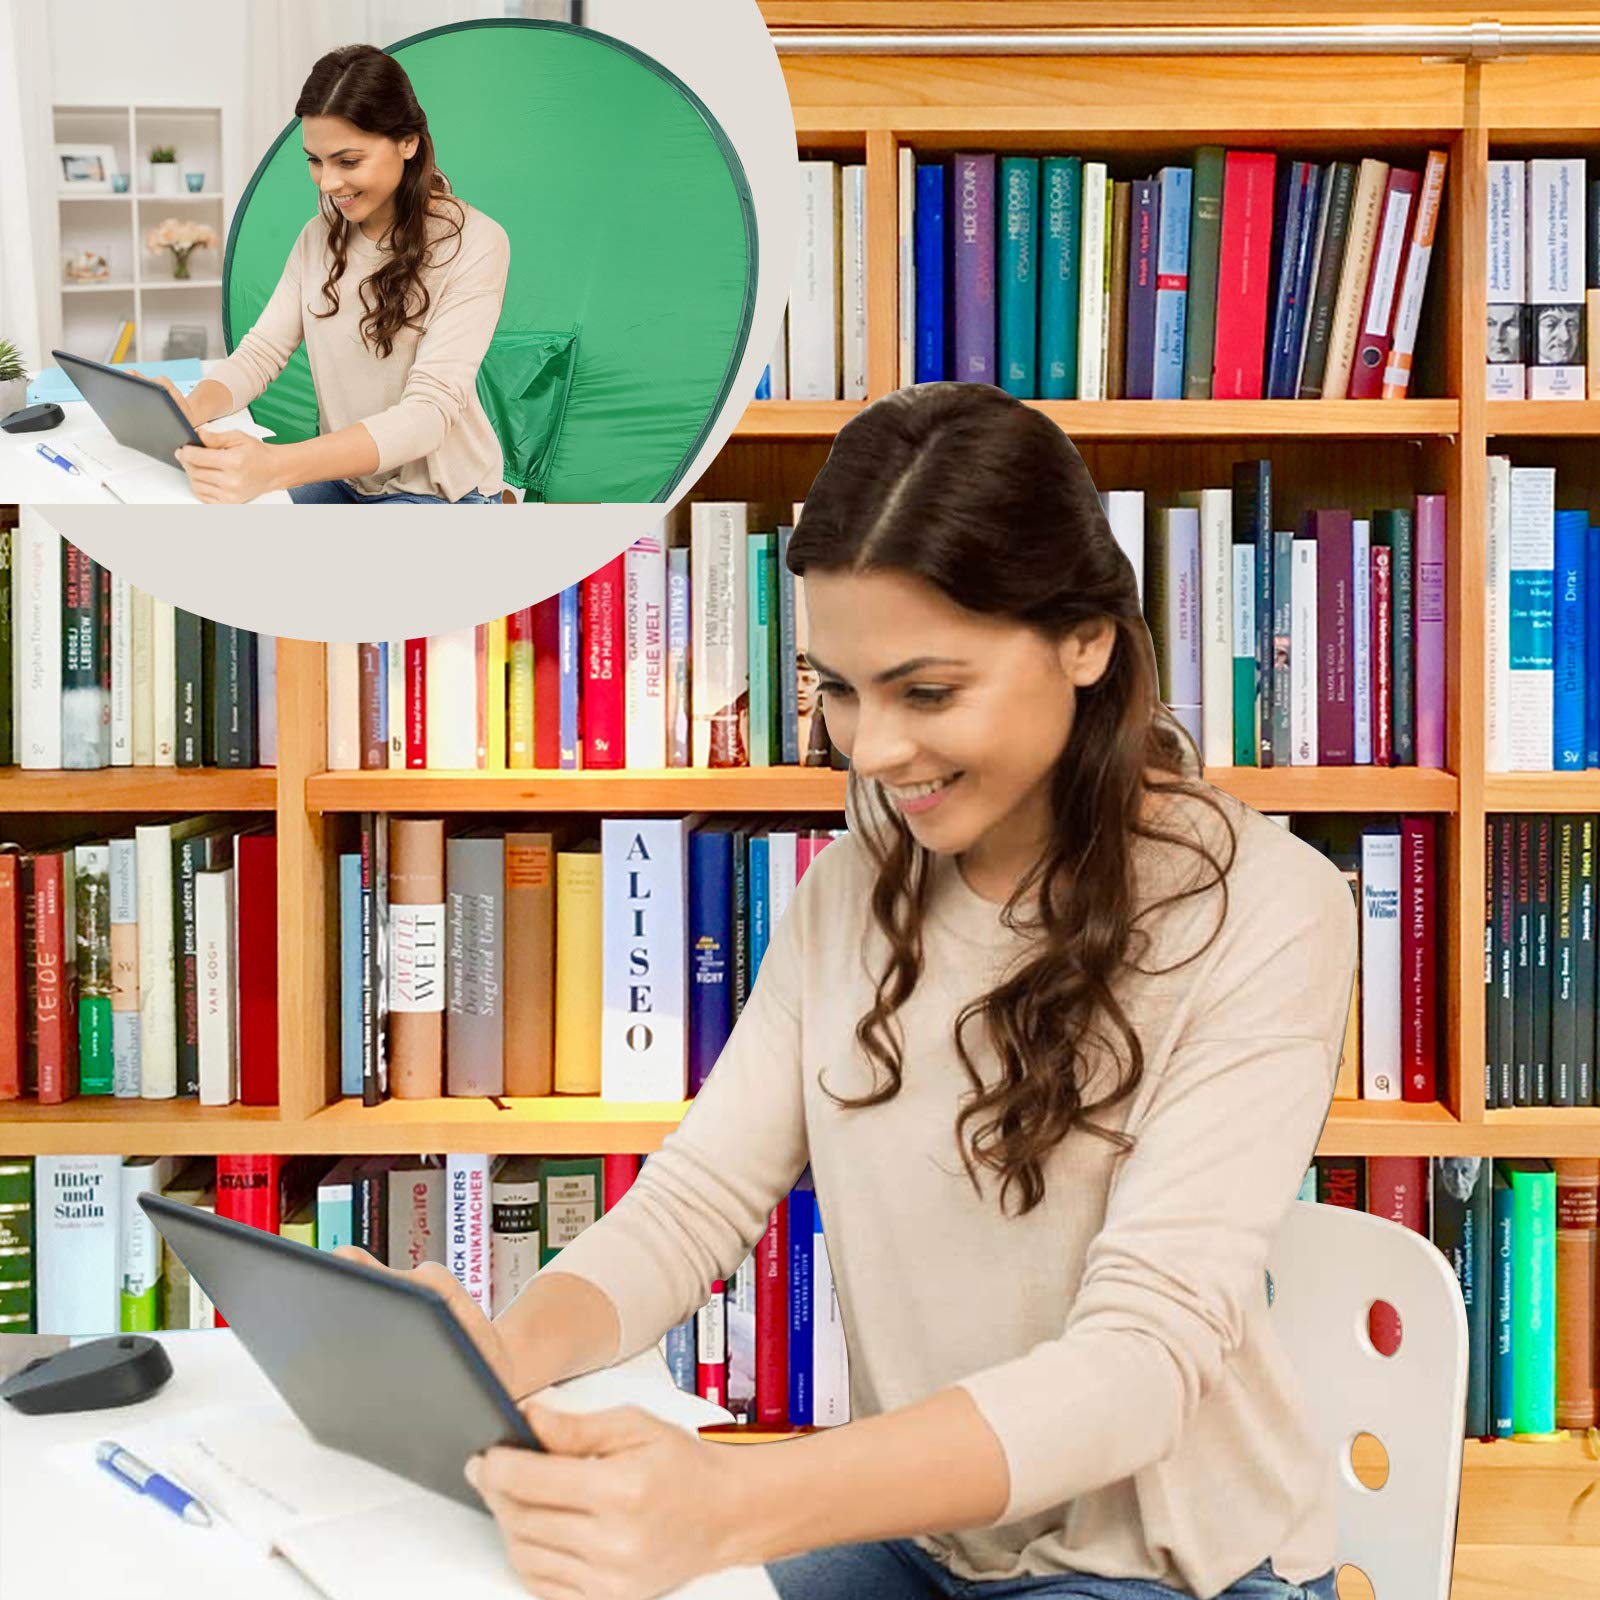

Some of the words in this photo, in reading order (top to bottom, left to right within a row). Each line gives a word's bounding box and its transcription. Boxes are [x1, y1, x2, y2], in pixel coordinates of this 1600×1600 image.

[963, 162, 977, 208] DOMIN
[1008, 169, 1022, 210] DOMIN
[1017, 170, 1029, 208] ESSAYS
[1050, 168, 1063, 208] DOMIN
[1059, 168, 1070, 207] ESSAYS
[1501, 166, 1511, 219] Philosophie
[1559, 167, 1571, 220] Philosophie
[963, 211, 978, 243] HILDE
[1008, 212, 1020, 240] HILDE
[1050, 211, 1063, 238] HILDE
[1331, 207, 1345, 238] LOUIS
[1491, 182, 1503, 244] Hirschberger
[1502, 221, 1511, 237] der
[1549, 184, 1562, 246] Hirschberger
[1560, 222, 1569, 238] der
[1491, 246, 1500, 290] Johannes
[1503, 240, 1511, 291] Geschichte
[1549, 248, 1557, 292] Johannes
[1559, 241, 1569, 292] Geschichte
[1173, 298, 1184, 336] Antunes
[1399, 515, 1412, 553] SUMMER
[627, 572, 638, 602] ASH
[1179, 571, 1188, 609] PRAGAL
[1400, 555, 1412, 591] BEFORE
[1565, 570, 1577, 602] Dirac
[589, 582, 600, 623] Hacker
[599, 582, 612, 657] Habenichtse
[671, 576, 685, 663] CAMILLERI
[1400, 593, 1412, 611] THE
[30, 604, 41, 642] Thome
[80, 616, 92, 670] LEBEDEW
[627, 604, 638, 661] GARTON
[645, 603, 661, 646] WELT
[1179, 611, 1188, 641] PETER
[1400, 612, 1412, 638] DARK
[31, 643, 43, 690] Stephan
[68, 627, 79, 671] SERGEJ
[590, 624, 600, 680] Katharina
[1326, 644, 1335, 665] GUO
[1564, 639, 1576, 692] Dietmar
[600, 659, 612, 680] Die
[645, 648, 662, 698] FREIE
[595, 739, 609, 751] SV
[1299, 741, 1310, 760] dtv
[1563, 750, 1579, 763] SV
[182, 844, 193, 879] Leben
[1413, 832, 1424, 884] JULIAN
[118, 847, 129, 920] Blumenberg
[183, 881, 193, 922] andere
[37, 890, 46, 944] ALESSANDRO
[451, 892, 463, 957] Bernhard
[479, 894, 494, 945] Unseld
[1413, 887, 1424, 939] BARNES
[1560, 916, 1570, 939] DER
[185, 924, 198, 956] Jenes
[207, 940, 218, 980] GOGH
[397, 914, 415, 1003] ZWEITE
[414, 914, 436, 1002] WELT
[463, 894, 481, 987] Briefwechsel
[626, 832, 653, 1052] ALISEO
[185, 957, 195, 988] Farah
[479, 949, 497, 1017] Siegfried
[1414, 947, 1422, 982] Nothing
[37, 951, 57, 1022] SEIDE
[208, 987, 218, 1015] VAN
[451, 959, 463, 1015] Thomas
[465, 989, 478, 1016] Der
[1561, 977, 1570, 1000] Georg
[186, 989, 196, 1045] Nuruddin
[116, 1054, 127, 1094] Sibylle
[53, 1172, 103, 1188] Hitler
[62, 1190, 94, 1203] und
[219, 1173, 268, 1190] STALIN
[53, 1204, 104, 1219] Stalin
[453, 1170, 466, 1244] BAHNERS
[469, 1170, 483, 1283] PANIKMACHER
[498, 1209, 533, 1217] HENRY
[499, 1220, 532, 1228] JAMES
[131, 1213, 145, 1259] KLEIST
[1498, 1217, 1512, 1258] Ostende
[768, 1261, 778, 1277] Die
